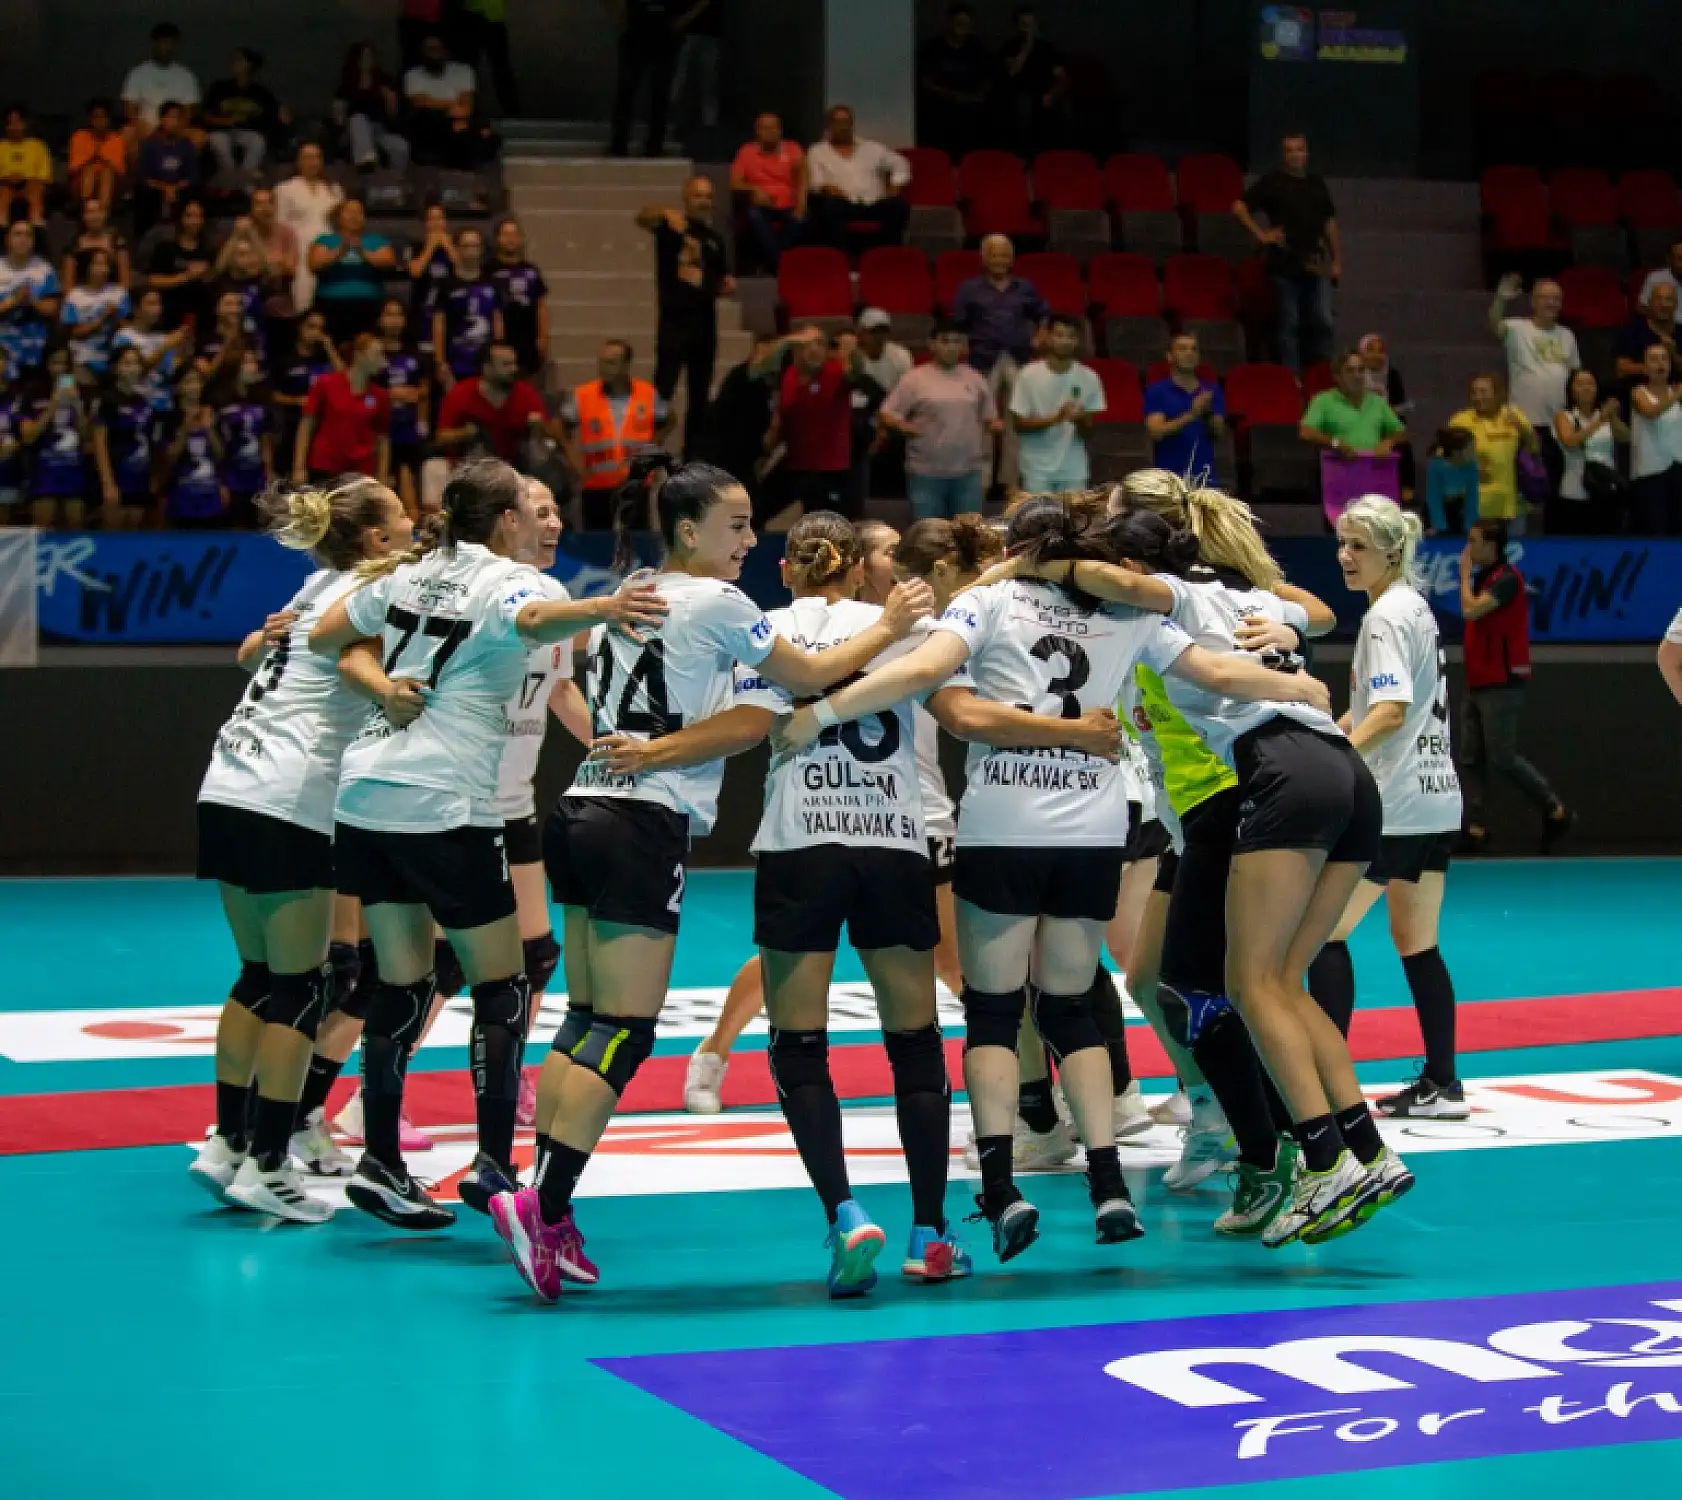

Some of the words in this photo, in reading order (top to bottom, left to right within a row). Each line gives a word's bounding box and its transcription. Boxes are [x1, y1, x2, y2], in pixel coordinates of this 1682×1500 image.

[385, 603, 473, 690] 77
[518, 671, 547, 710] 17
[984, 760, 1074, 790] YALIKAVAK
[803, 811, 897, 838] YALIKAVAK
[1233, 1407, 1486, 1459] For
